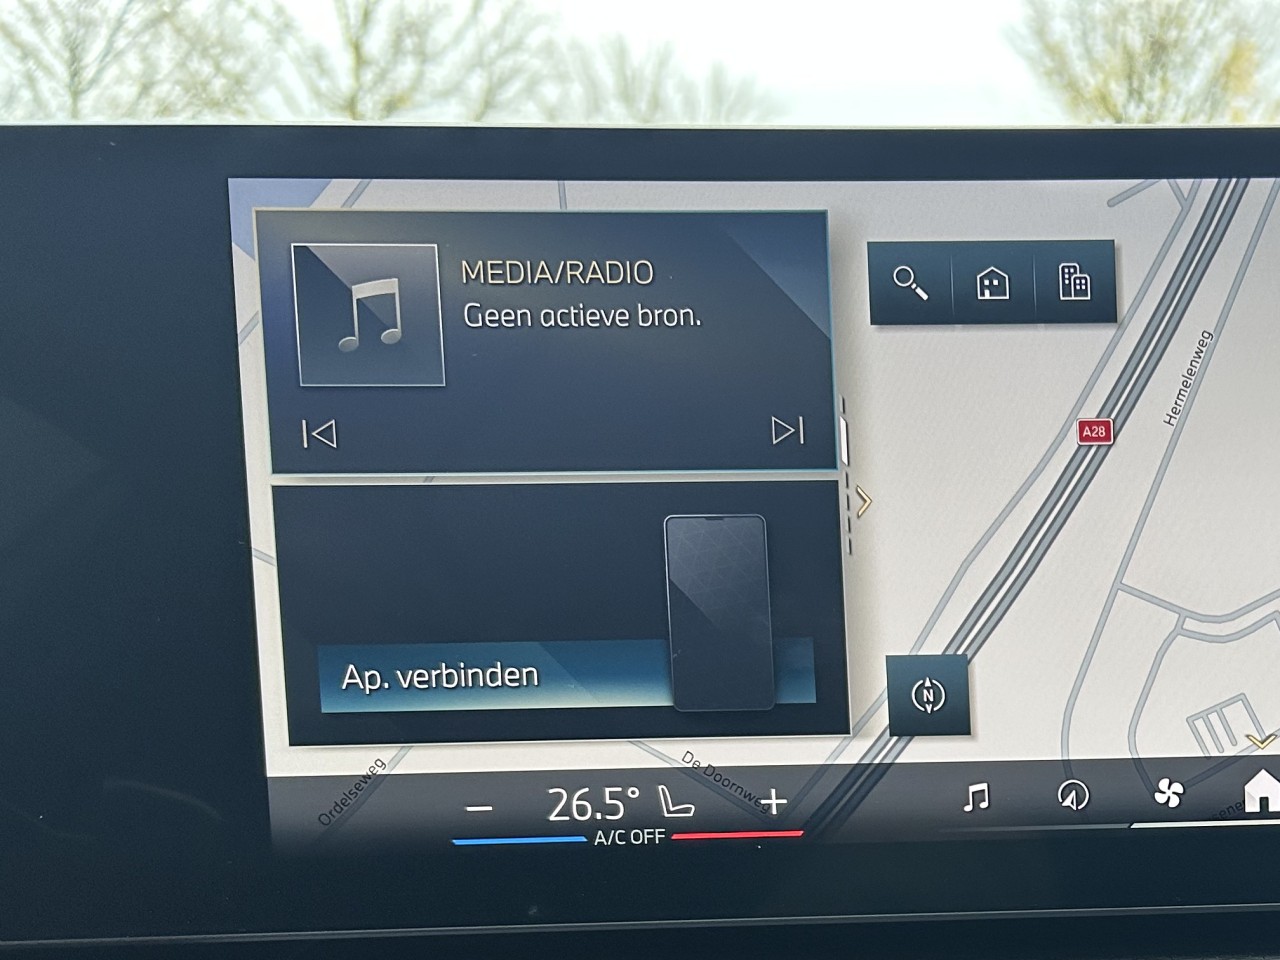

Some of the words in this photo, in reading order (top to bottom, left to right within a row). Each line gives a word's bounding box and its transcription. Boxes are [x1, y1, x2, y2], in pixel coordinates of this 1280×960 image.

[461, 258, 655, 285] MEDIA/RADIO
[463, 302, 533, 328] Geen
[540, 303, 631, 328] actieve
[637, 302, 702, 328] bron.
[1163, 329, 1214, 428] Hermelenweg
[1082, 425, 1106, 439] A28
[341, 663, 390, 695] Ap.
[396, 660, 540, 690] verbinden
[317, 757, 387, 827] Ordelseweg
[681, 749, 701, 770] De
[702, 763, 772, 815] Doornweg
[548, 786, 641, 821] 26.5°
[594, 829, 627, 847] A/C
[630, 828, 667, 845] OFF
